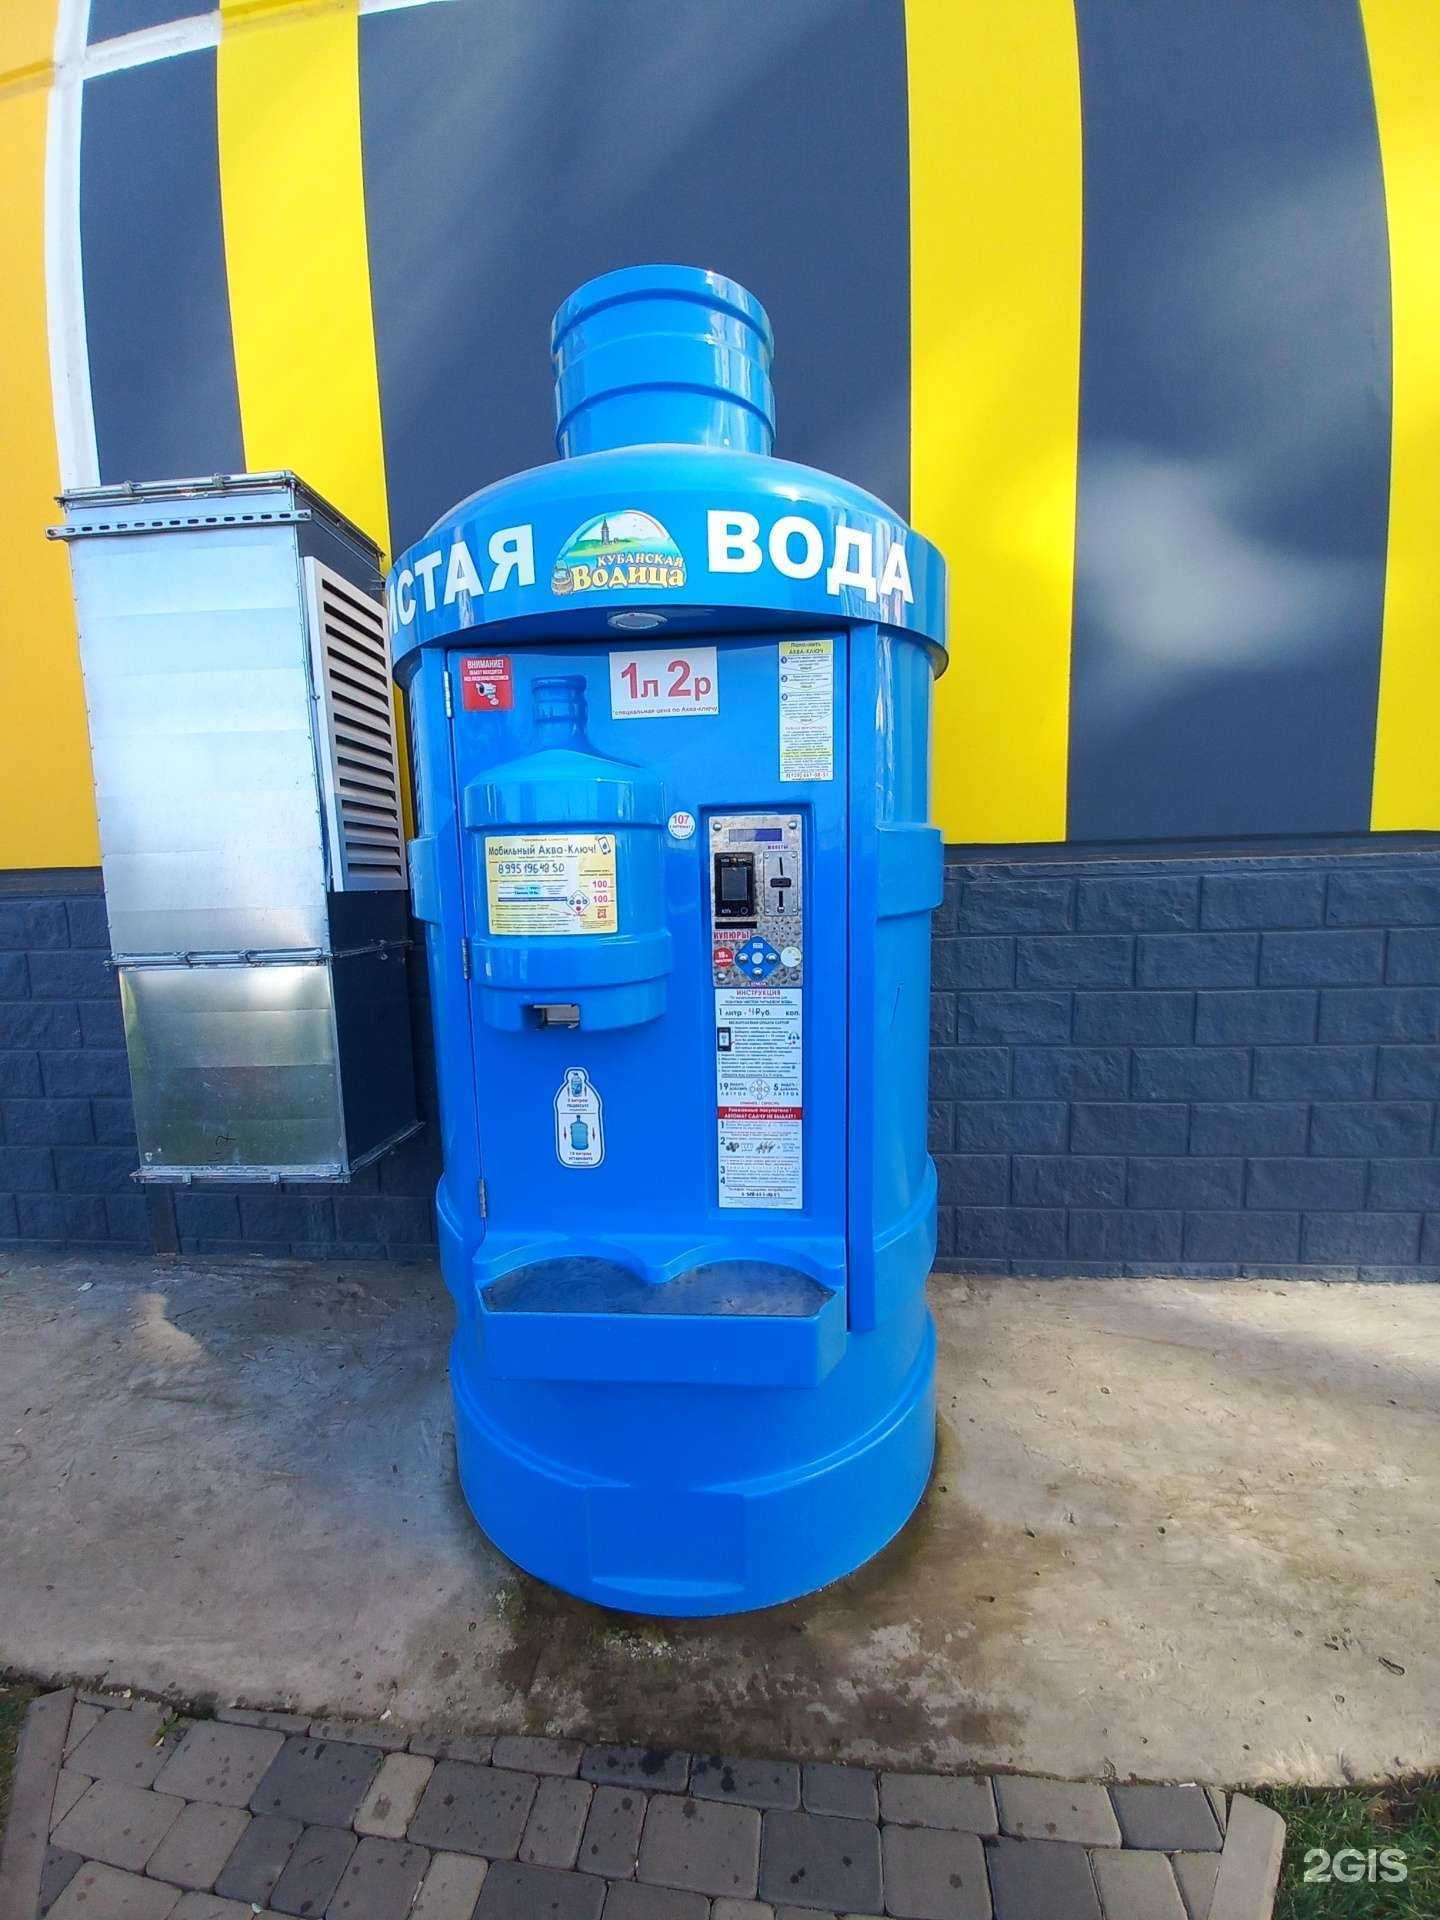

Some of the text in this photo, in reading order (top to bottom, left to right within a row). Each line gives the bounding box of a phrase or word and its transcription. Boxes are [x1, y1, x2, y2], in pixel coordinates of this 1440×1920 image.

[597, 552, 684, 568] КУБАНСКАЯ
[707, 510, 914, 604] ВОДА
[621, 659, 712, 701] 1л 2р
[672, 814, 690, 825] 107
[488, 844, 536, 856] Мобильный
[592, 880, 608, 889] 100
[593, 895, 608, 903] 100
